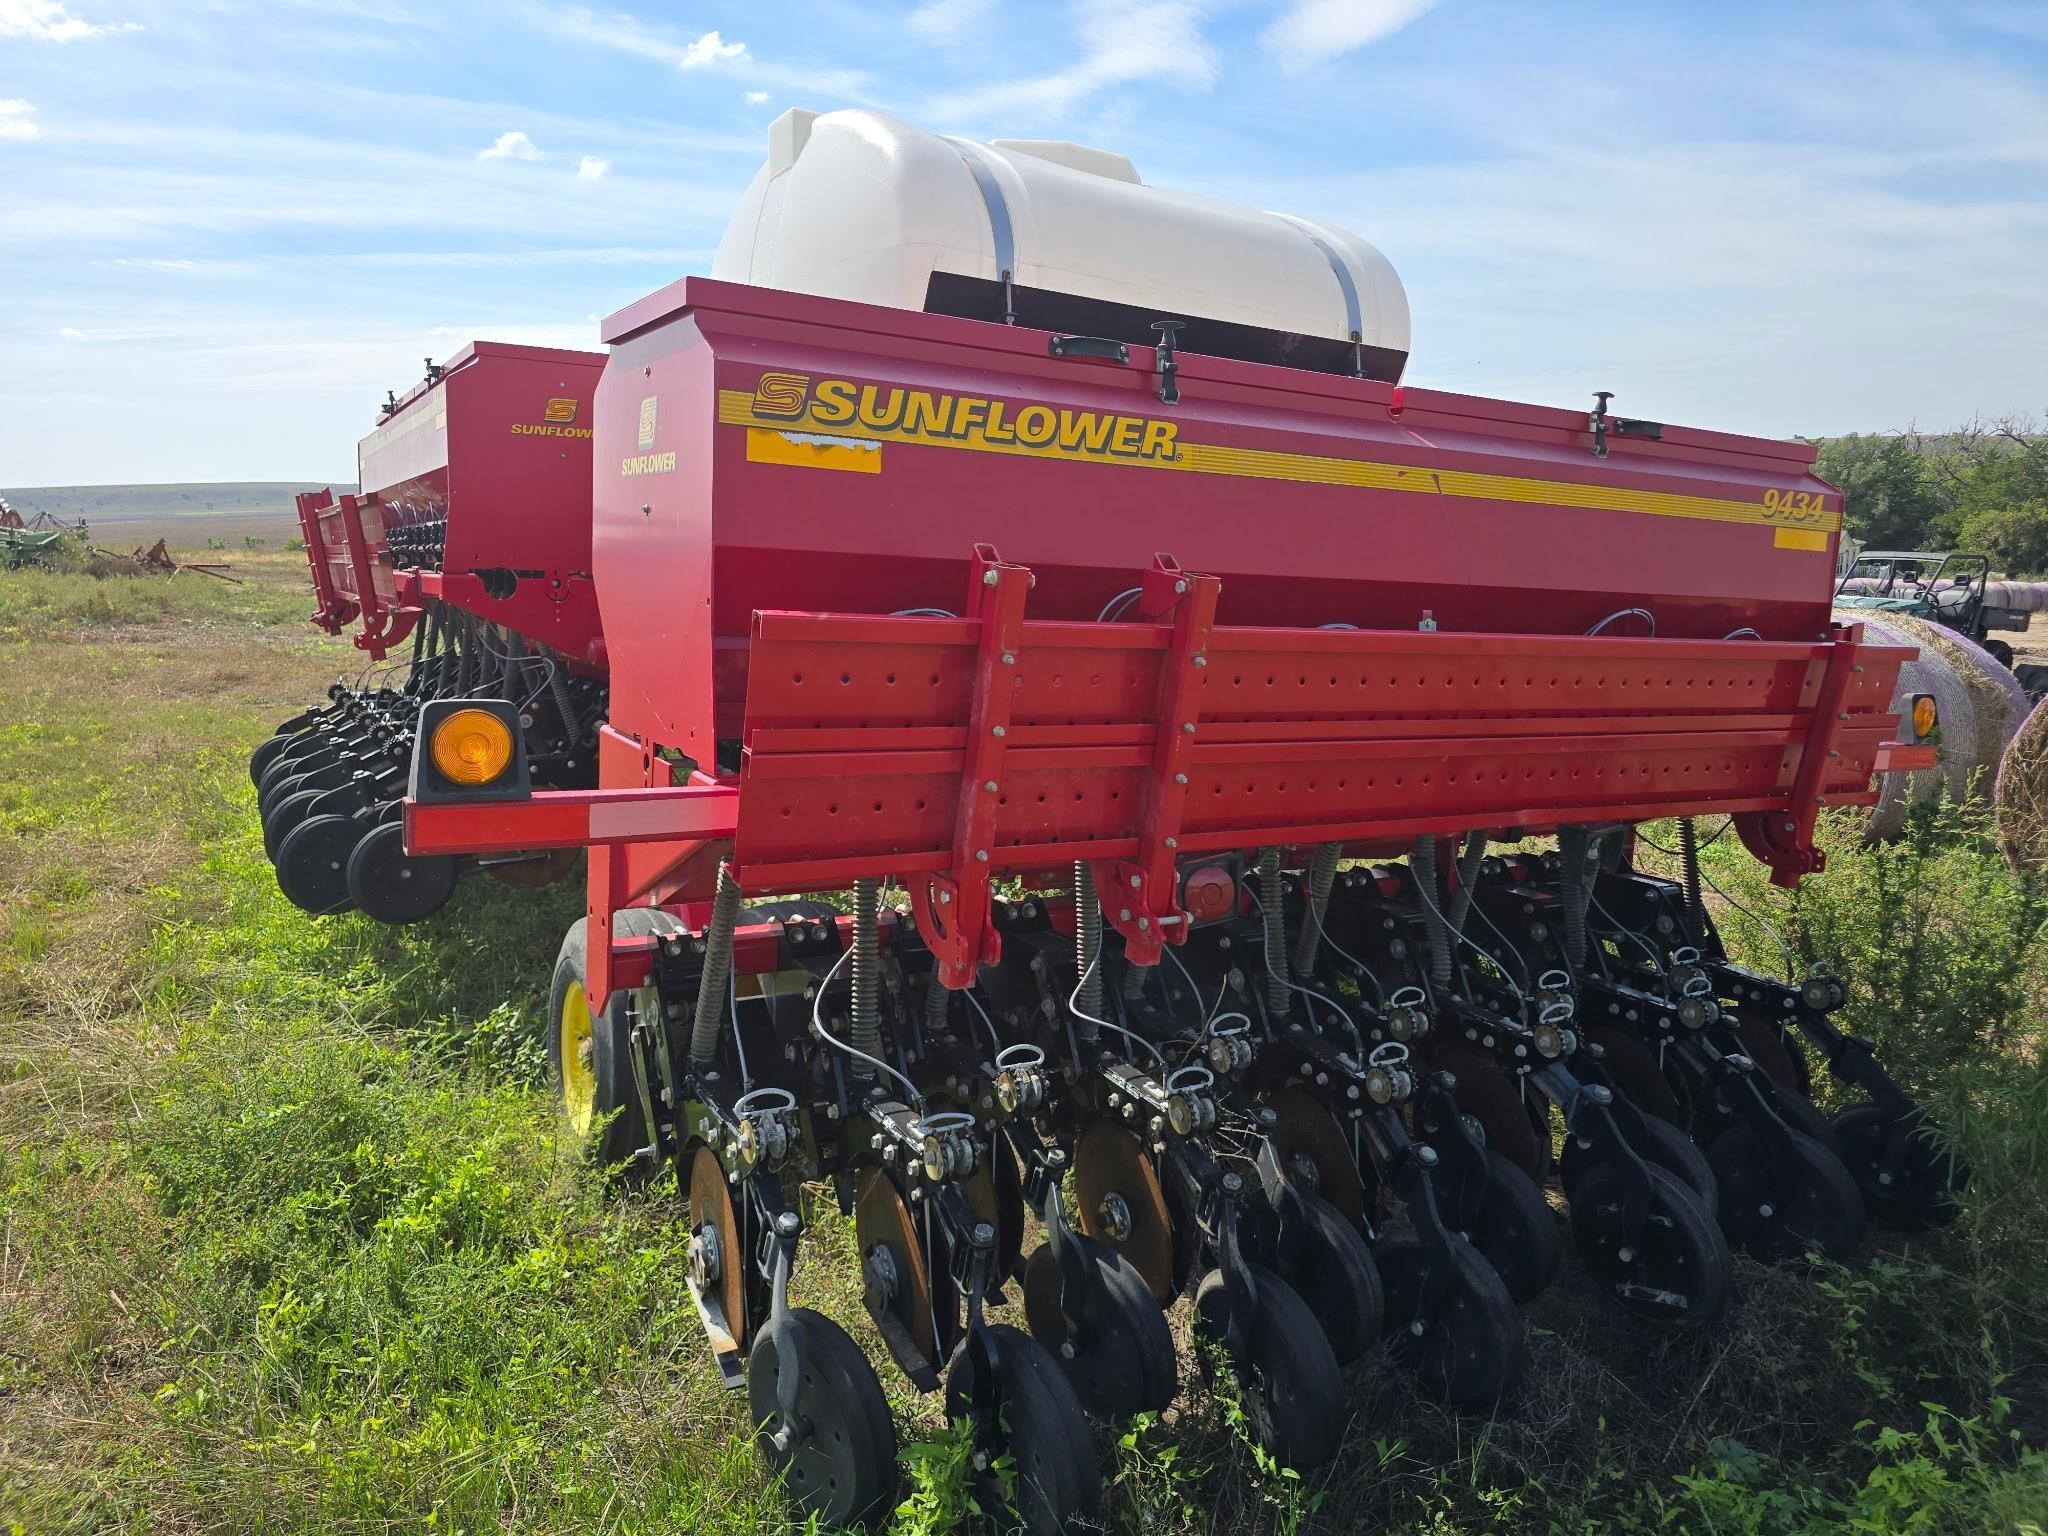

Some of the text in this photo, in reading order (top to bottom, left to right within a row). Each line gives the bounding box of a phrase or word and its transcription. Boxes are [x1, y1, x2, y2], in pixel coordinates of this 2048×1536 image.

[510, 424, 594, 439] SUNFLOW
[810, 380, 1178, 462] SUNFLOWER
[620, 451, 676, 477] SUNFLOWER
[1760, 488, 1825, 523] 9434
